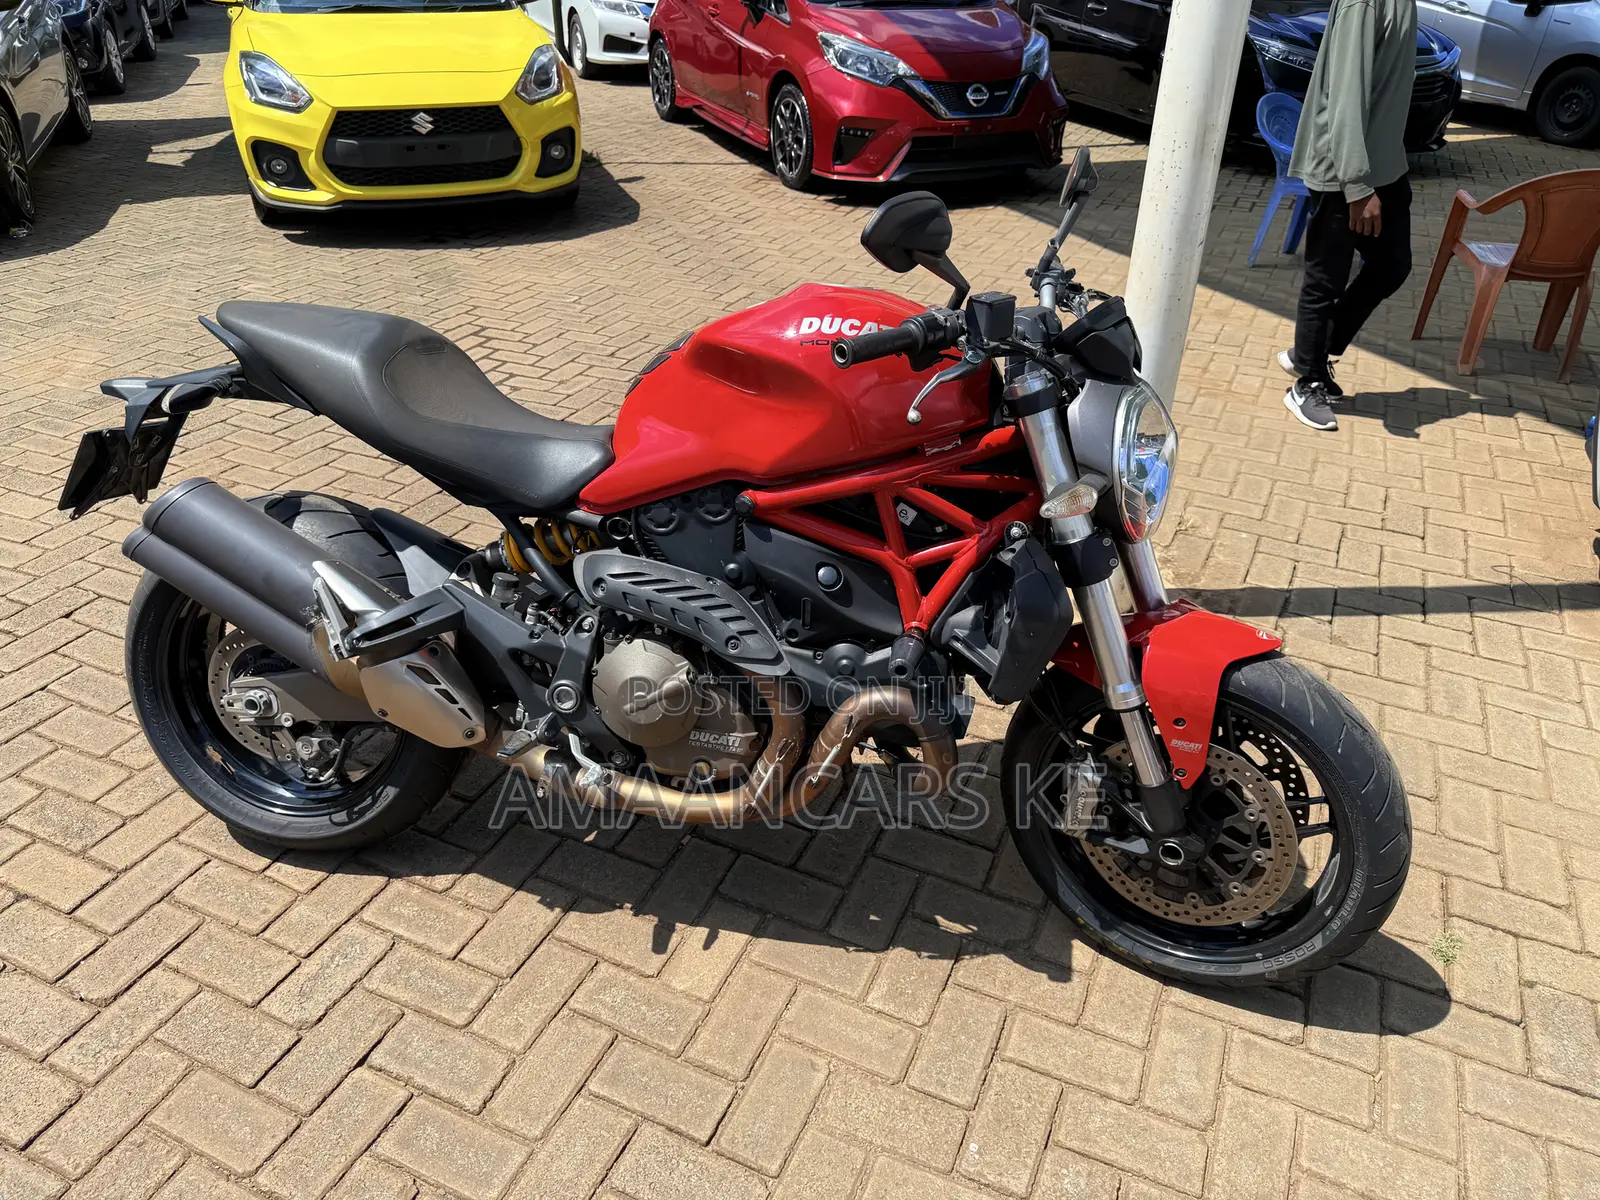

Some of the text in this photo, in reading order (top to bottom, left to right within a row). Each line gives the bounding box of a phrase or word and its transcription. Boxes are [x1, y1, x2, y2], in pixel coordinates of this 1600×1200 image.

[689, 730, 741, 747] DUCATI
[1171, 739, 1203, 750] DUCATI
[1073, 789, 1087, 828] brembo
[1330, 868, 1364, 930] DIABLO
[1262, 941, 1317, 970] ROSSO
